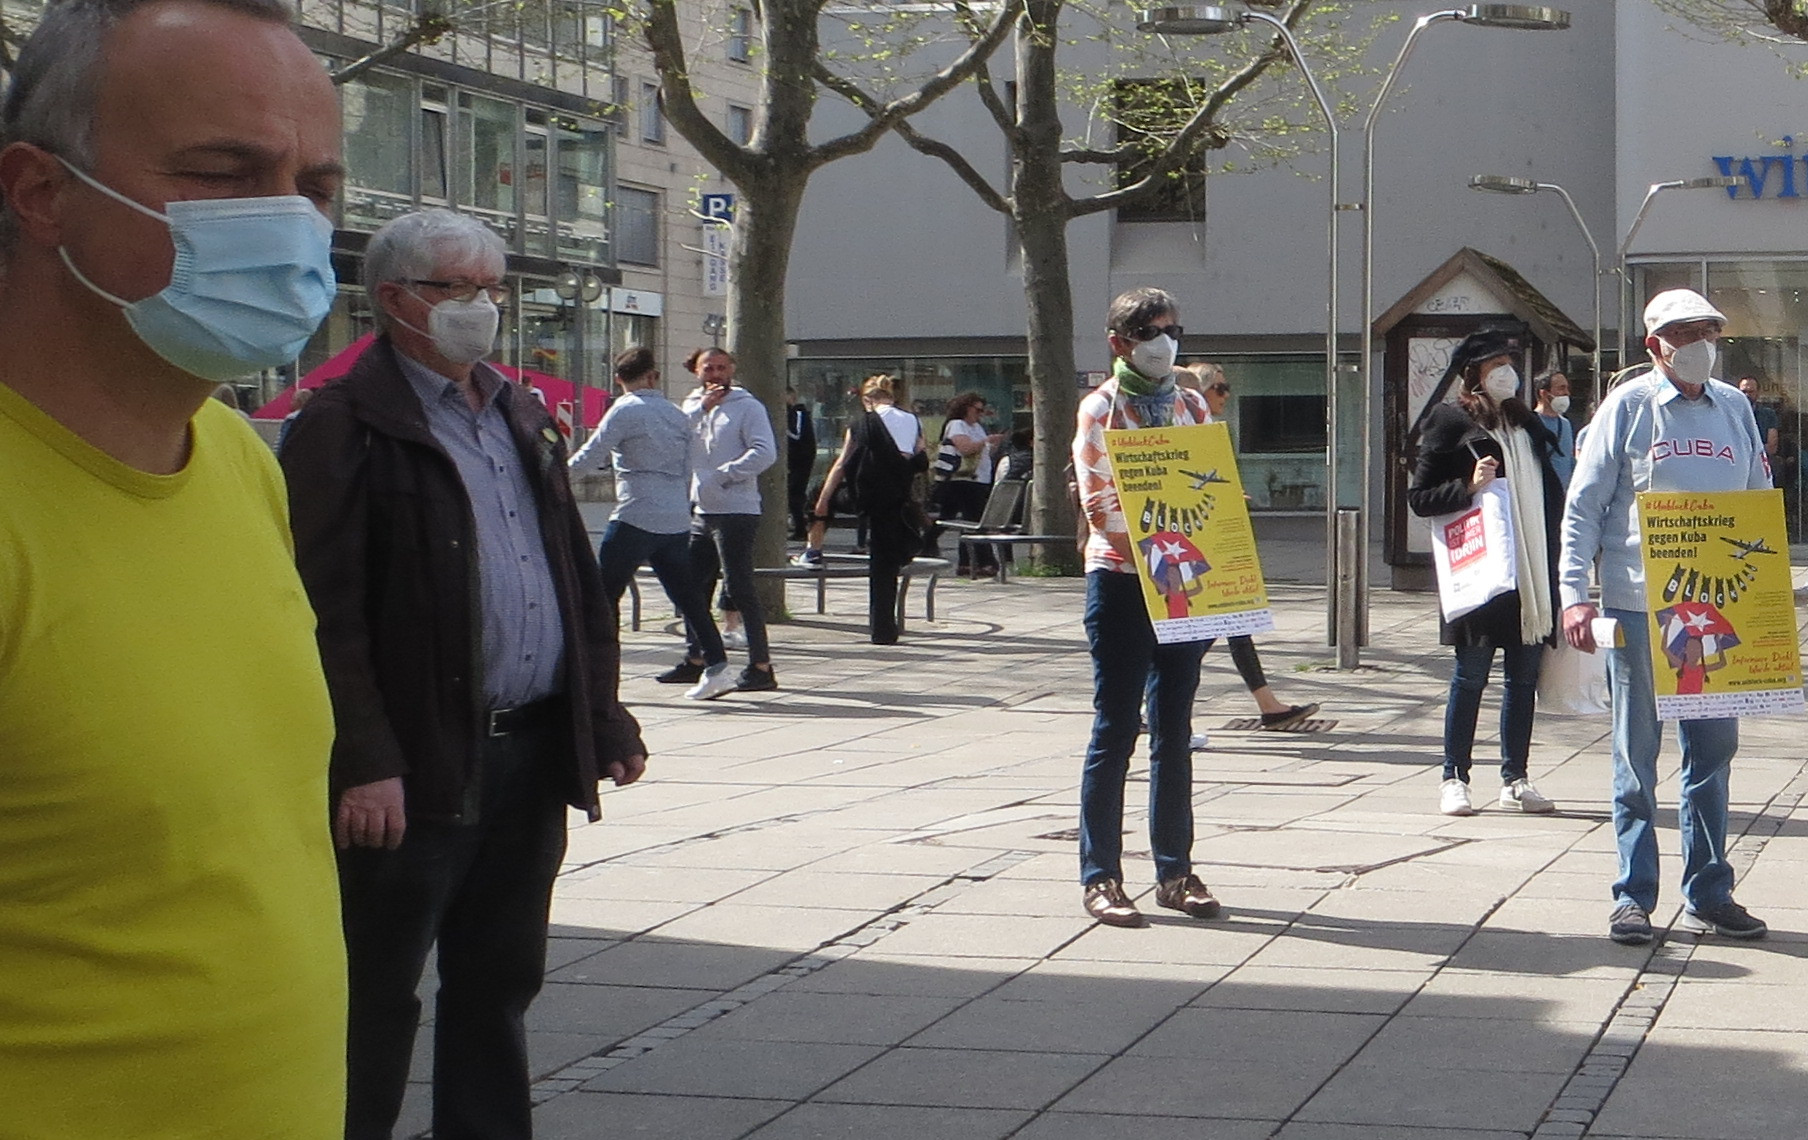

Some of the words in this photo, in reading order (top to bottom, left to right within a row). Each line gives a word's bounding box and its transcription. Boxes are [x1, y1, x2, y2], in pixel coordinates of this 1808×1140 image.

[709, 198, 727, 217] P
[1115, 449, 1190, 463] Wirtschaftskrieg
[1651, 439, 1735, 465] CUBA
[1119, 467, 1144, 479] gegen
[1145, 465, 1168, 477] Kuba
[1646, 514, 1736, 529] Wirtschaftskrieg
[1648, 533, 1679, 546] gegen
[1680, 531, 1707, 543] Kuba
[1649, 546, 1698, 559] beenden!
